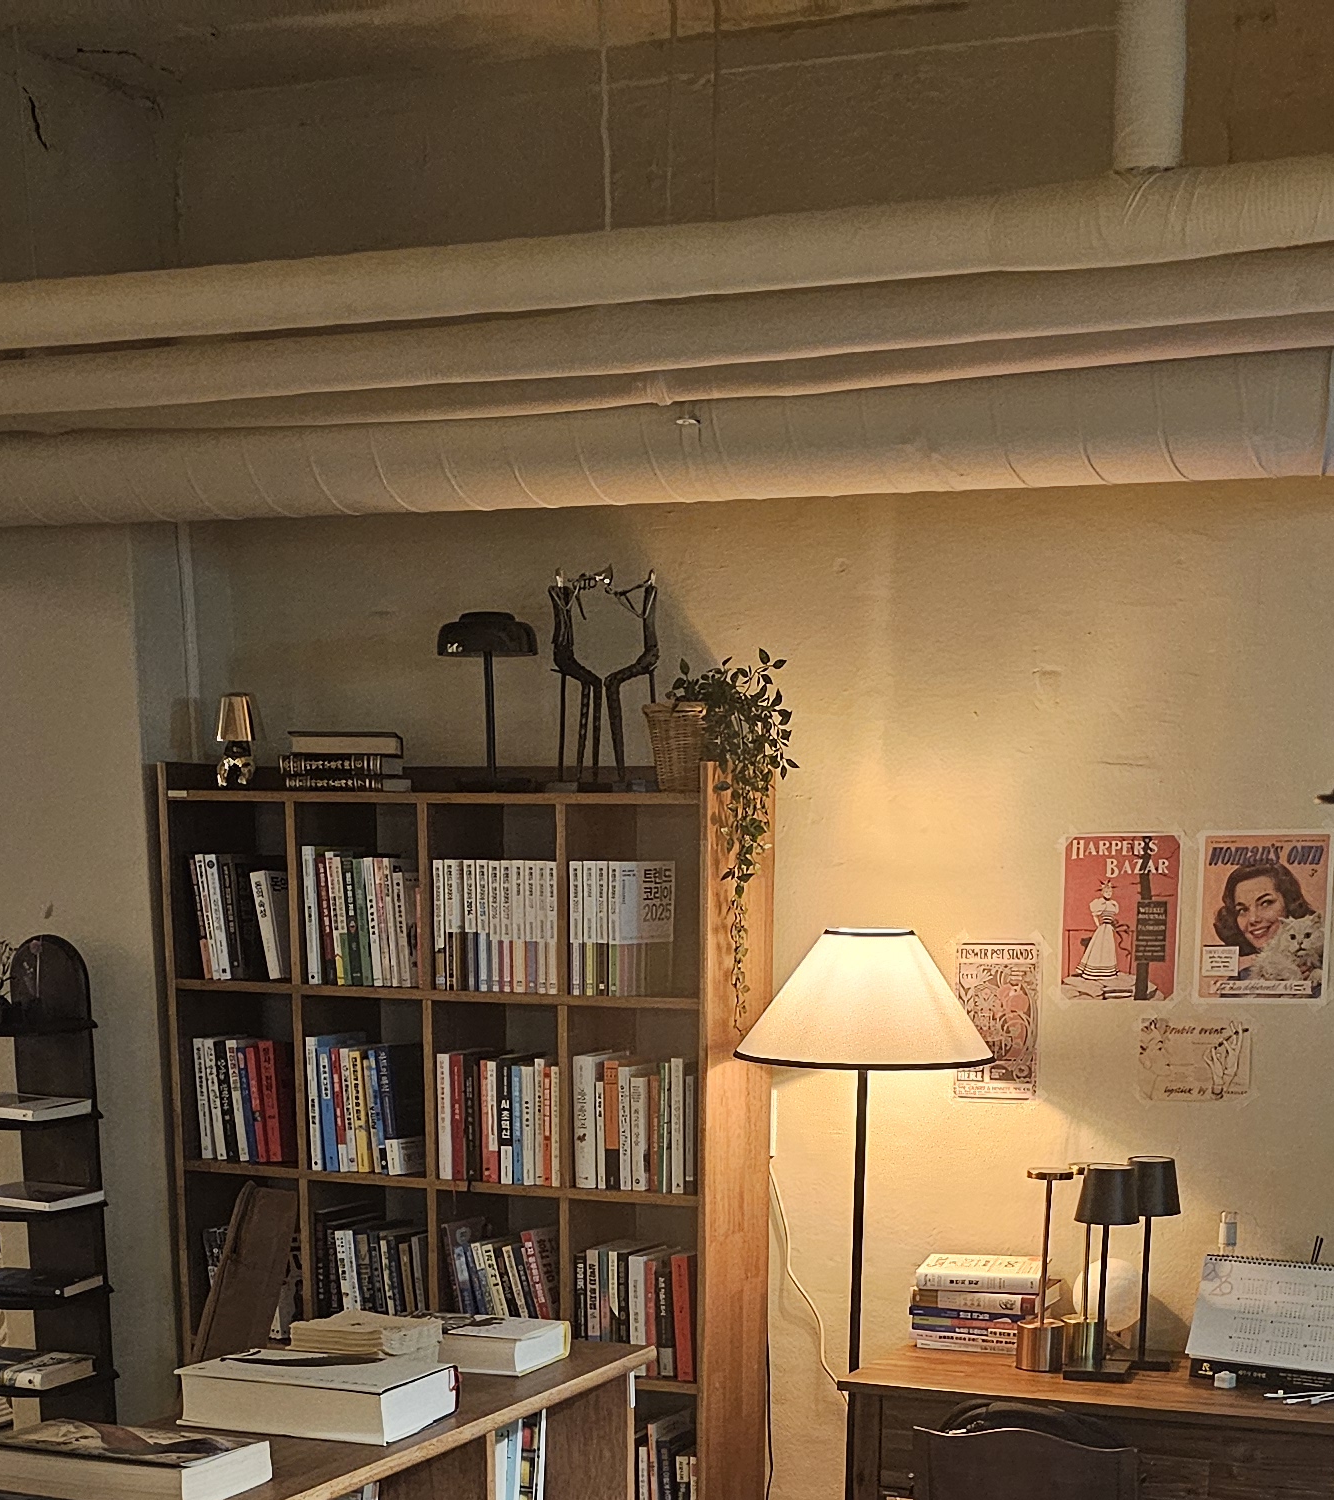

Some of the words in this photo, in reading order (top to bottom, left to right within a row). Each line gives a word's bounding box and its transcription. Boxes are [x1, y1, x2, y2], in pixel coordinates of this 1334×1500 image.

[1070, 839, 1159, 860] HARPER'S
[643, 868, 672, 885] 트렌드
[1106, 859, 1170, 878] BAZAR
[643, 885, 672, 901] 코리아
[643, 903, 672, 923] 2025
[960, 948, 989, 960] FLOWER
[990, 948, 1005, 959] POT
[1007, 948, 1034, 960] STANDS
[501, 1099, 510, 1109] AI
